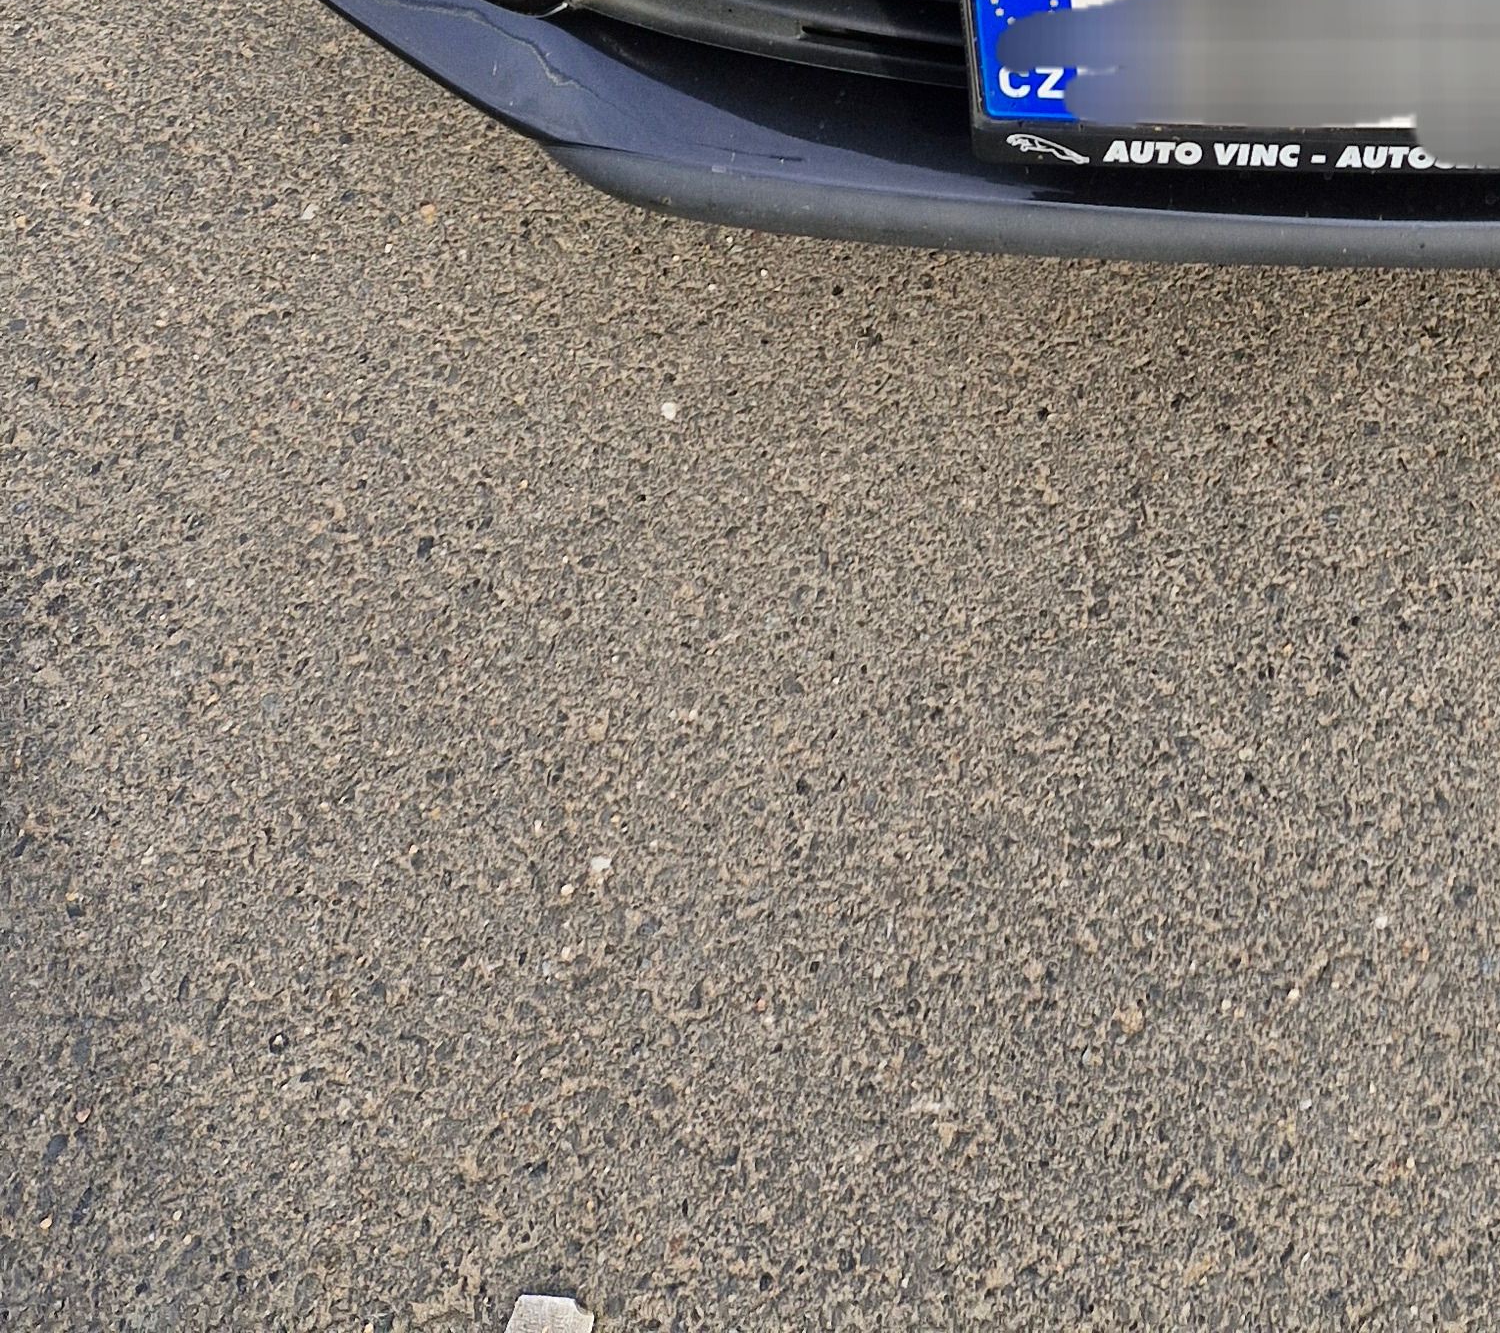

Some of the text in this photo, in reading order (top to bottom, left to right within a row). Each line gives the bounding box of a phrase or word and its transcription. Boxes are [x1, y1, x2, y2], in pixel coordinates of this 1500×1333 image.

[998, 65, 1065, 99] CZ
[1102, 140, 1203, 166] AUTO
[1213, 143, 1301, 168] VINC
